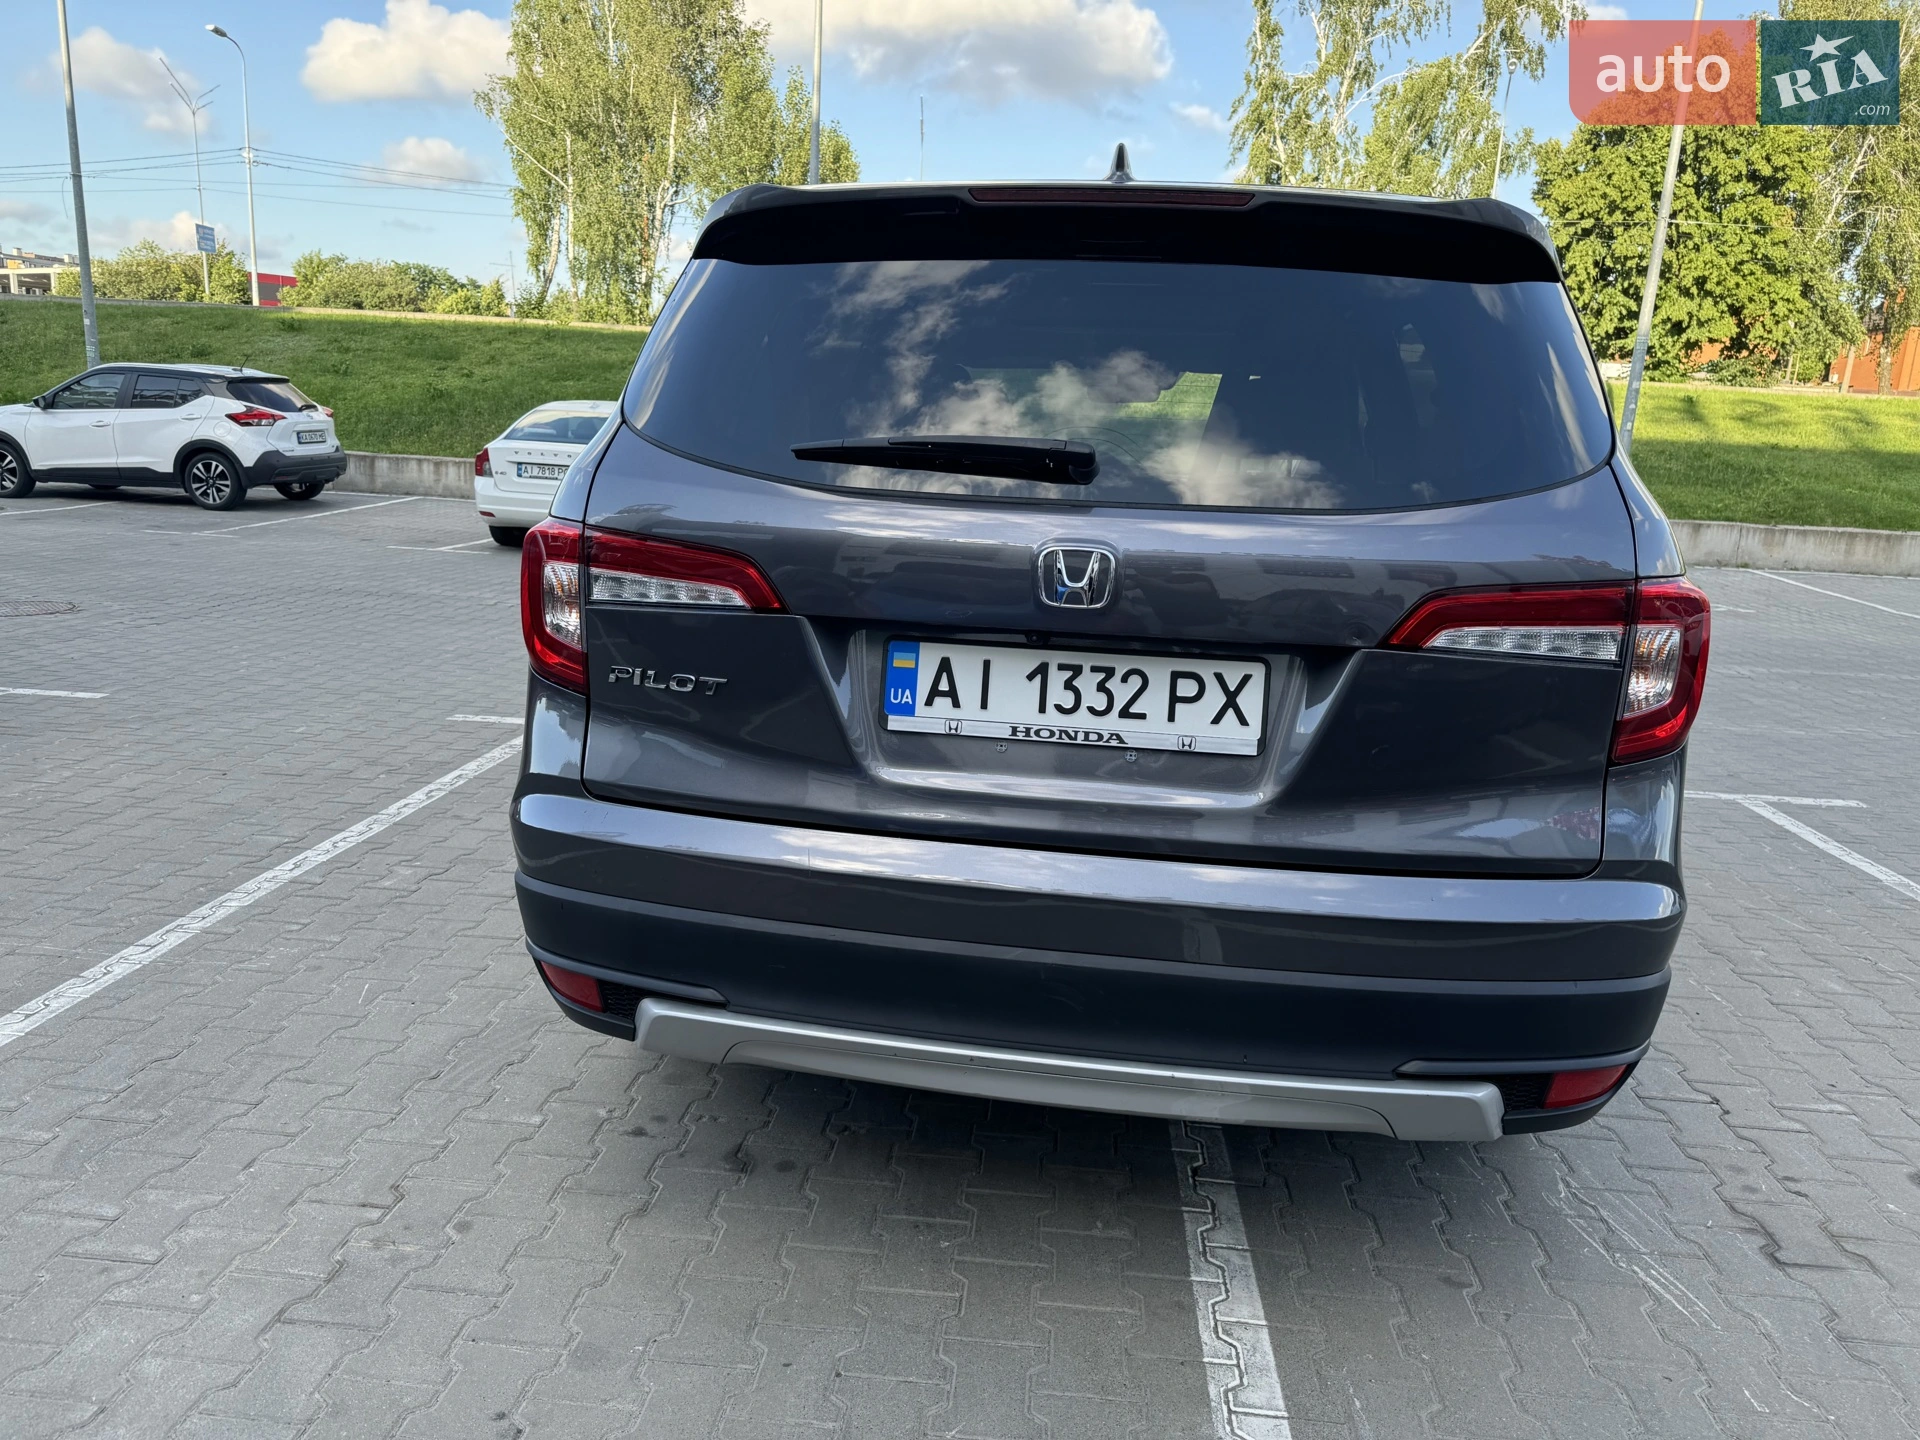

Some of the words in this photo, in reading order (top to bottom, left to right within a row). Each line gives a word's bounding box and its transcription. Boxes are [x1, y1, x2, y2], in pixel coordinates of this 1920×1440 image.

[514, 450, 572, 458] VOLVO
[523, 465, 534, 475] AI
[537, 466, 556, 475] 7818
[608, 665, 728, 695] PILOT
[890, 688, 913, 705] UA
[924, 656, 991, 710] AI
[1025, 661, 1150, 720] 1332
[1167, 670, 1253, 727] PX
[1008, 725, 1129, 745] HONDA
